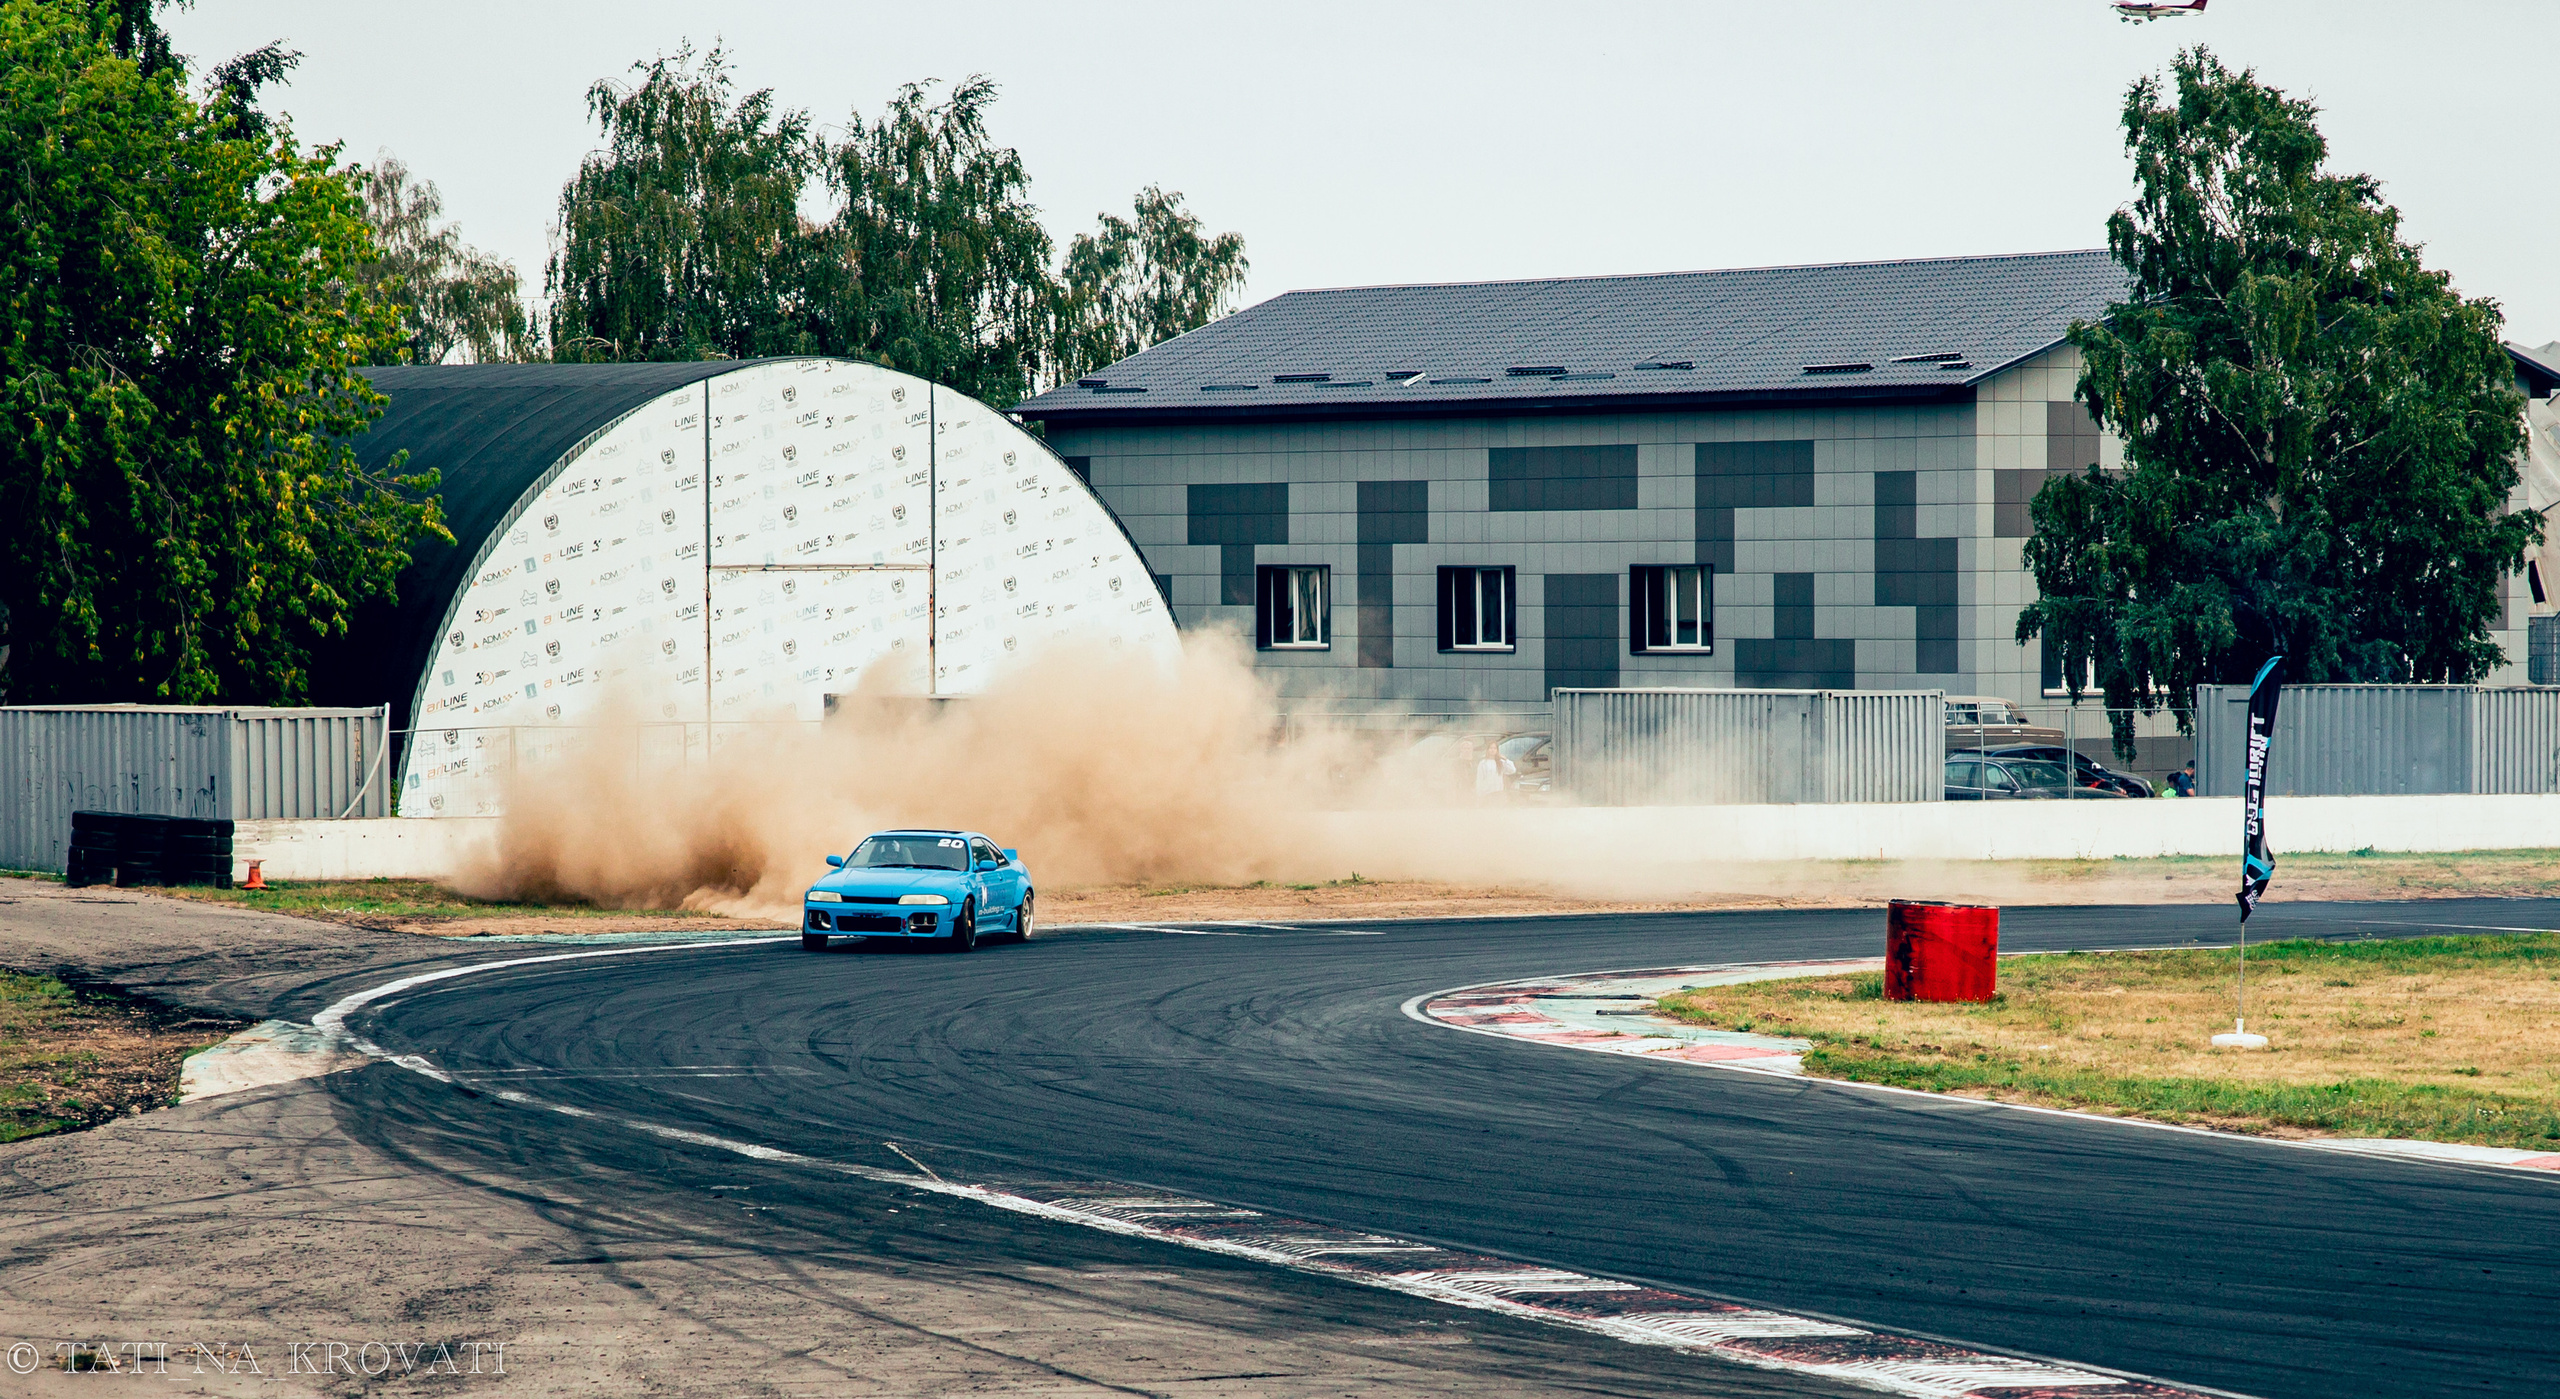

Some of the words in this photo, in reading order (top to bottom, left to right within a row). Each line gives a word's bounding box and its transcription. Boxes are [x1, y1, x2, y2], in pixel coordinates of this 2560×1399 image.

[722, 442, 740, 453] ADM
[832, 442, 851, 453] ADM
[945, 447, 964, 459] ADM
[600, 501, 618, 513] ADM
[722, 498, 741, 509] ADM
[833, 497, 851, 508] ADM
[945, 502, 964, 514] ADM
[600, 570, 618, 582] ADM
[945, 570, 964, 581] ADM
[482, 633, 502, 646] ADM
[600, 632, 618, 644] ADM
[722, 632, 741, 643] ADM
[832, 631, 850, 642] ADM
[482, 698, 502, 710] ADM
[938, 838, 965, 849] 20
